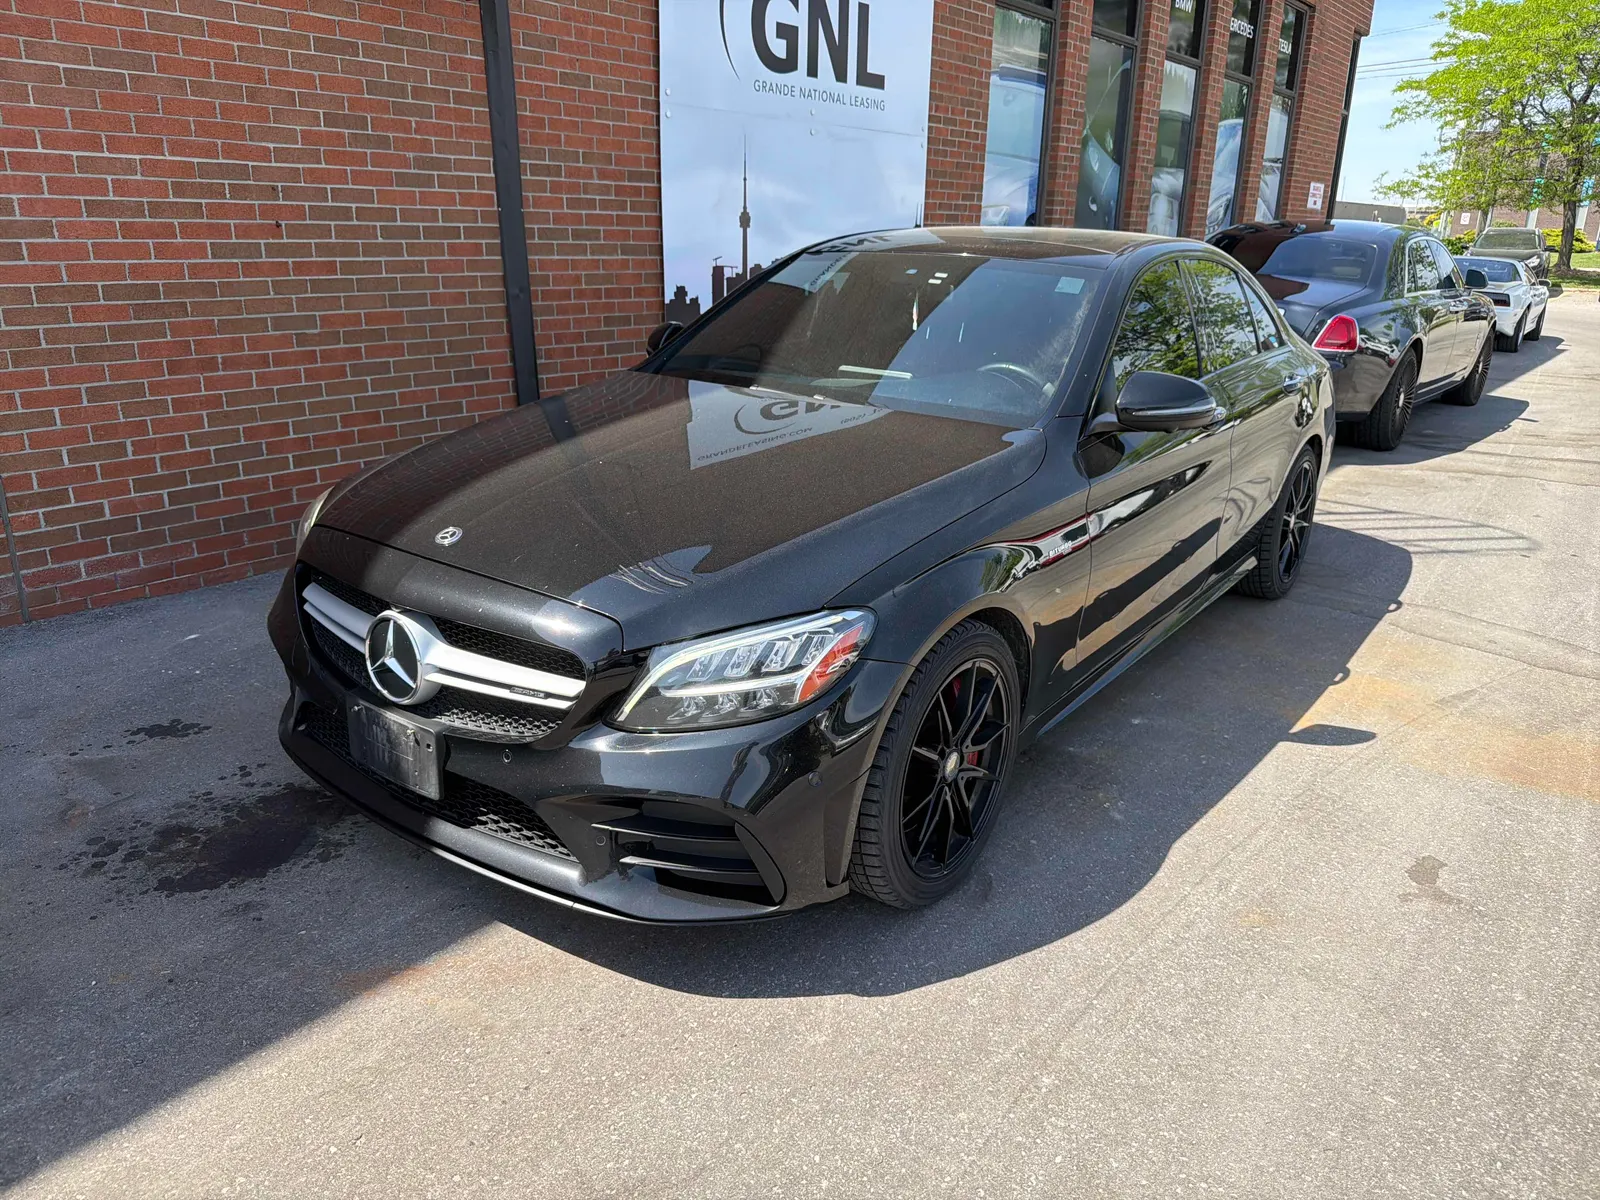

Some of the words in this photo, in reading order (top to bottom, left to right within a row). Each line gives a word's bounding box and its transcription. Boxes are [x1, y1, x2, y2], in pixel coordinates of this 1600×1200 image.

[1175, 0, 1194, 13] BMW
[1229, 17, 1254, 39] ERCEDES
[751, 0, 885, 91] GNL
[1278, 38, 1292, 56] TESLA
[753, 79, 796, 98] GRANDE
[799, 86, 847, 106] NATIONAL
[849, 95, 886, 111] LEASING
